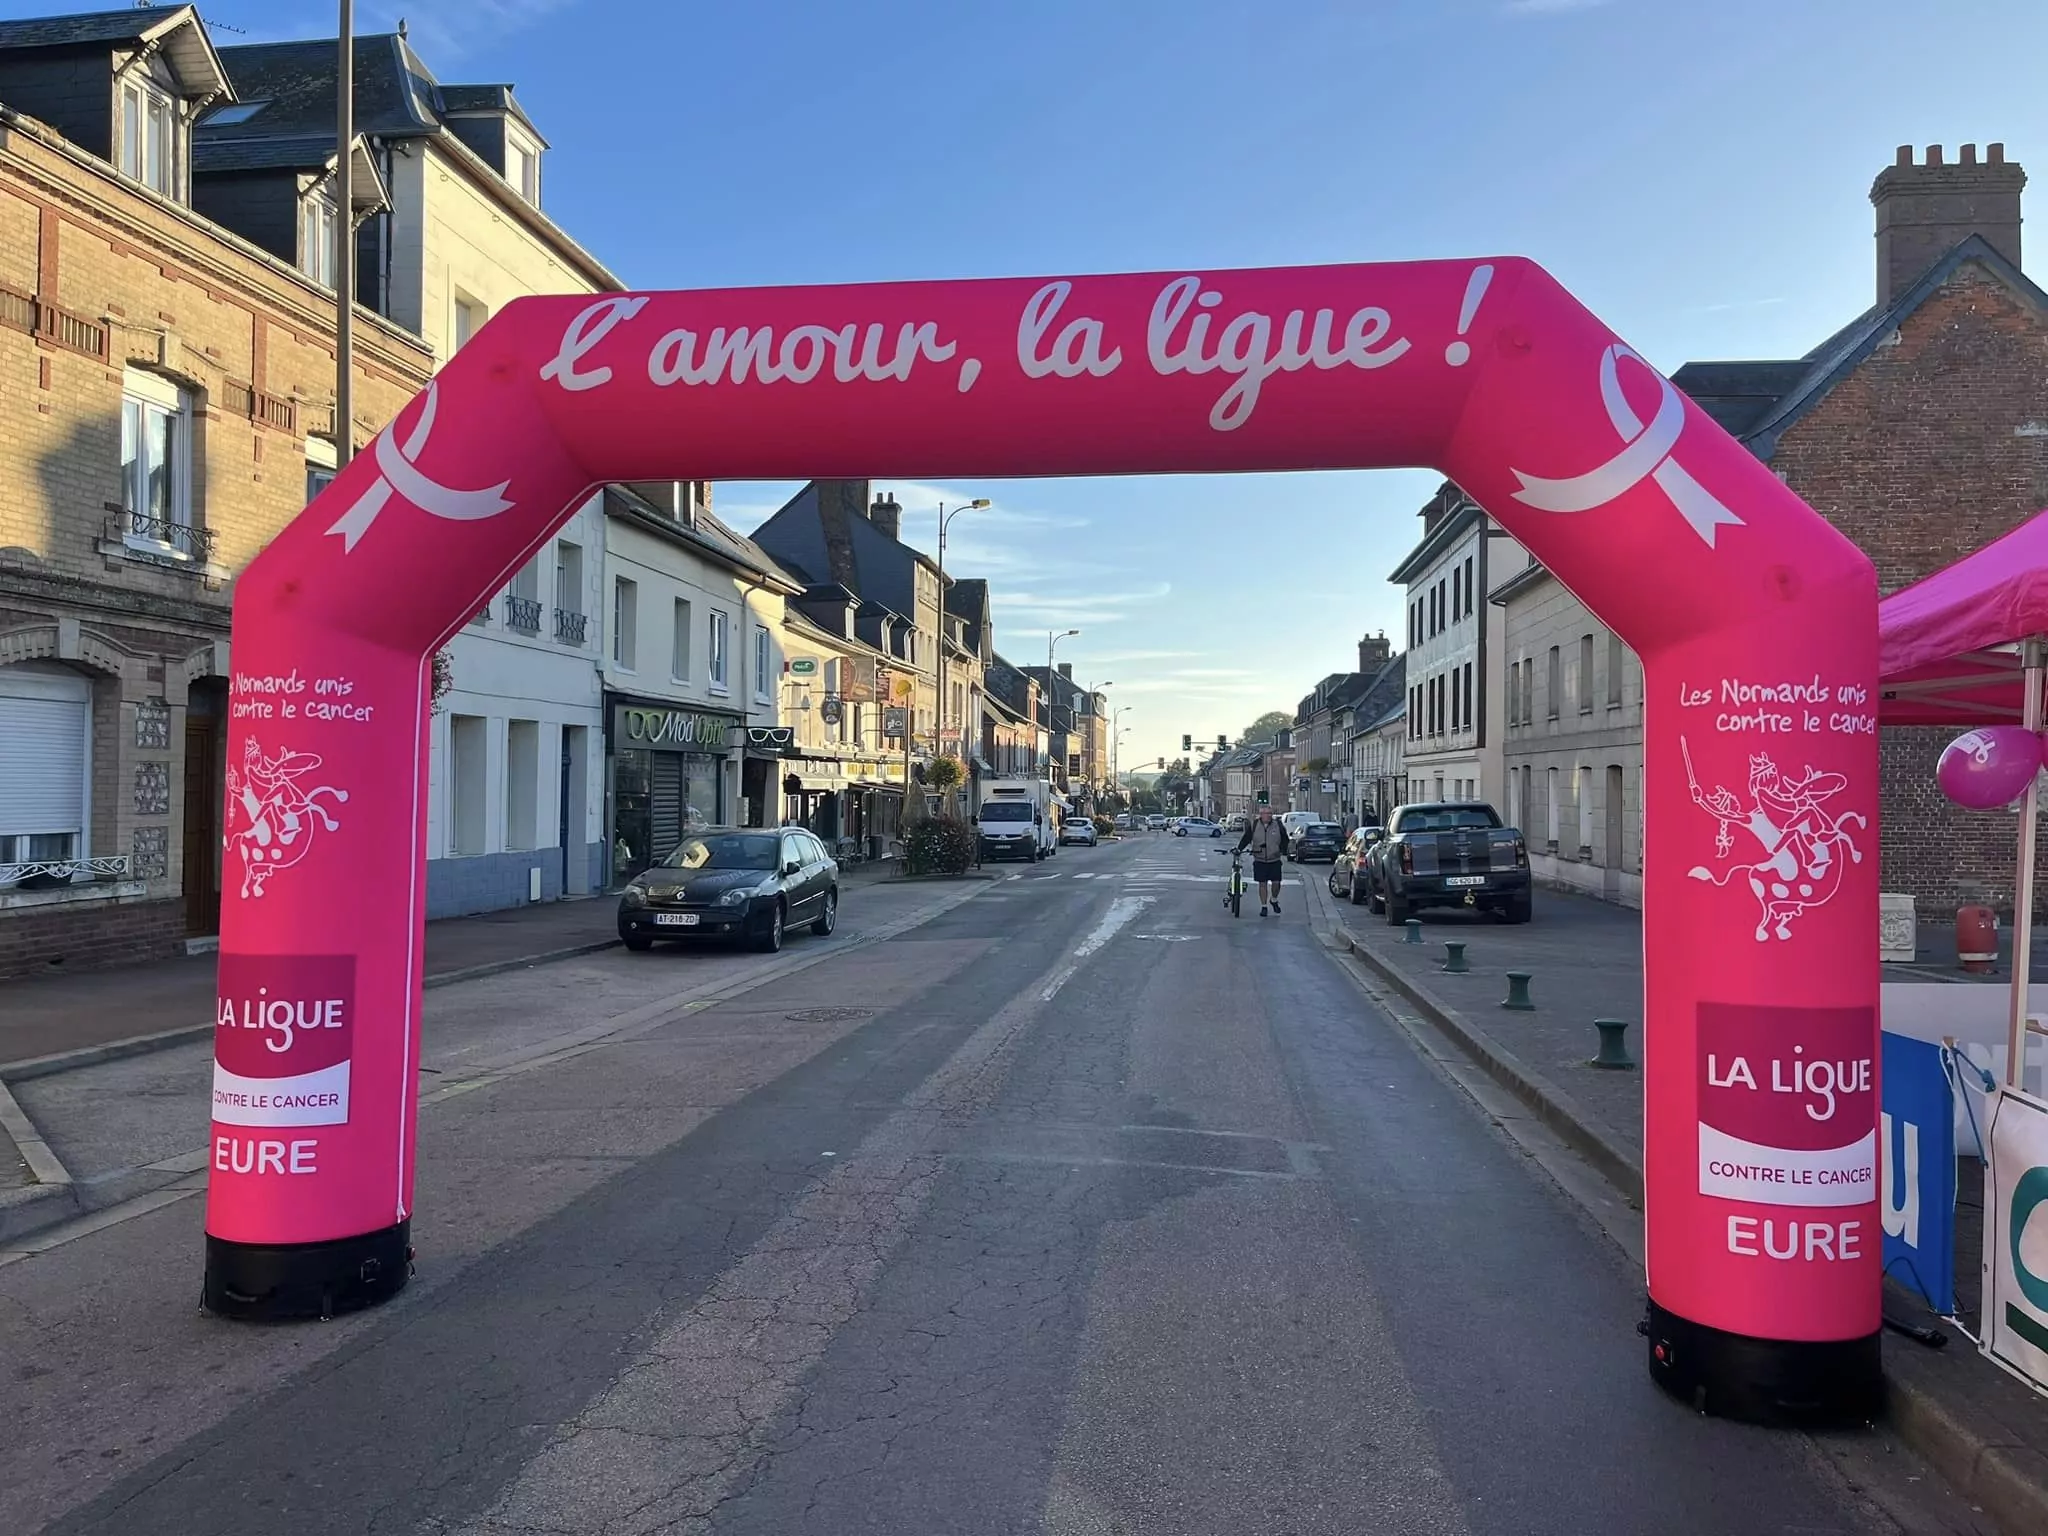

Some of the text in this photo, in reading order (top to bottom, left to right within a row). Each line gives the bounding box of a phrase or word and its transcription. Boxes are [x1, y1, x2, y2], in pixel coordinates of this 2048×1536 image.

[1017, 281, 1122, 378] la
[1147, 276, 1411, 431] ligue
[1445, 264, 1494, 366] !
[235, 668, 306, 697] Normands
[314, 676, 353, 696] unis
[1680, 674, 1866, 707] Les Normands unis
[233, 696, 374, 722] contre le cancer
[1716, 707, 1876, 735] contre le cancer
[217, 996, 237, 1028] LA
[1707, 1053, 1758, 1091] LA
[214, 1089, 339, 1109] CONTRE LE CANCER
[215, 1136, 318, 1175] EURE
[1709, 1161, 1872, 1185] CONTRE LE CANCER
[1727, 1215, 1861, 1262] EURE
